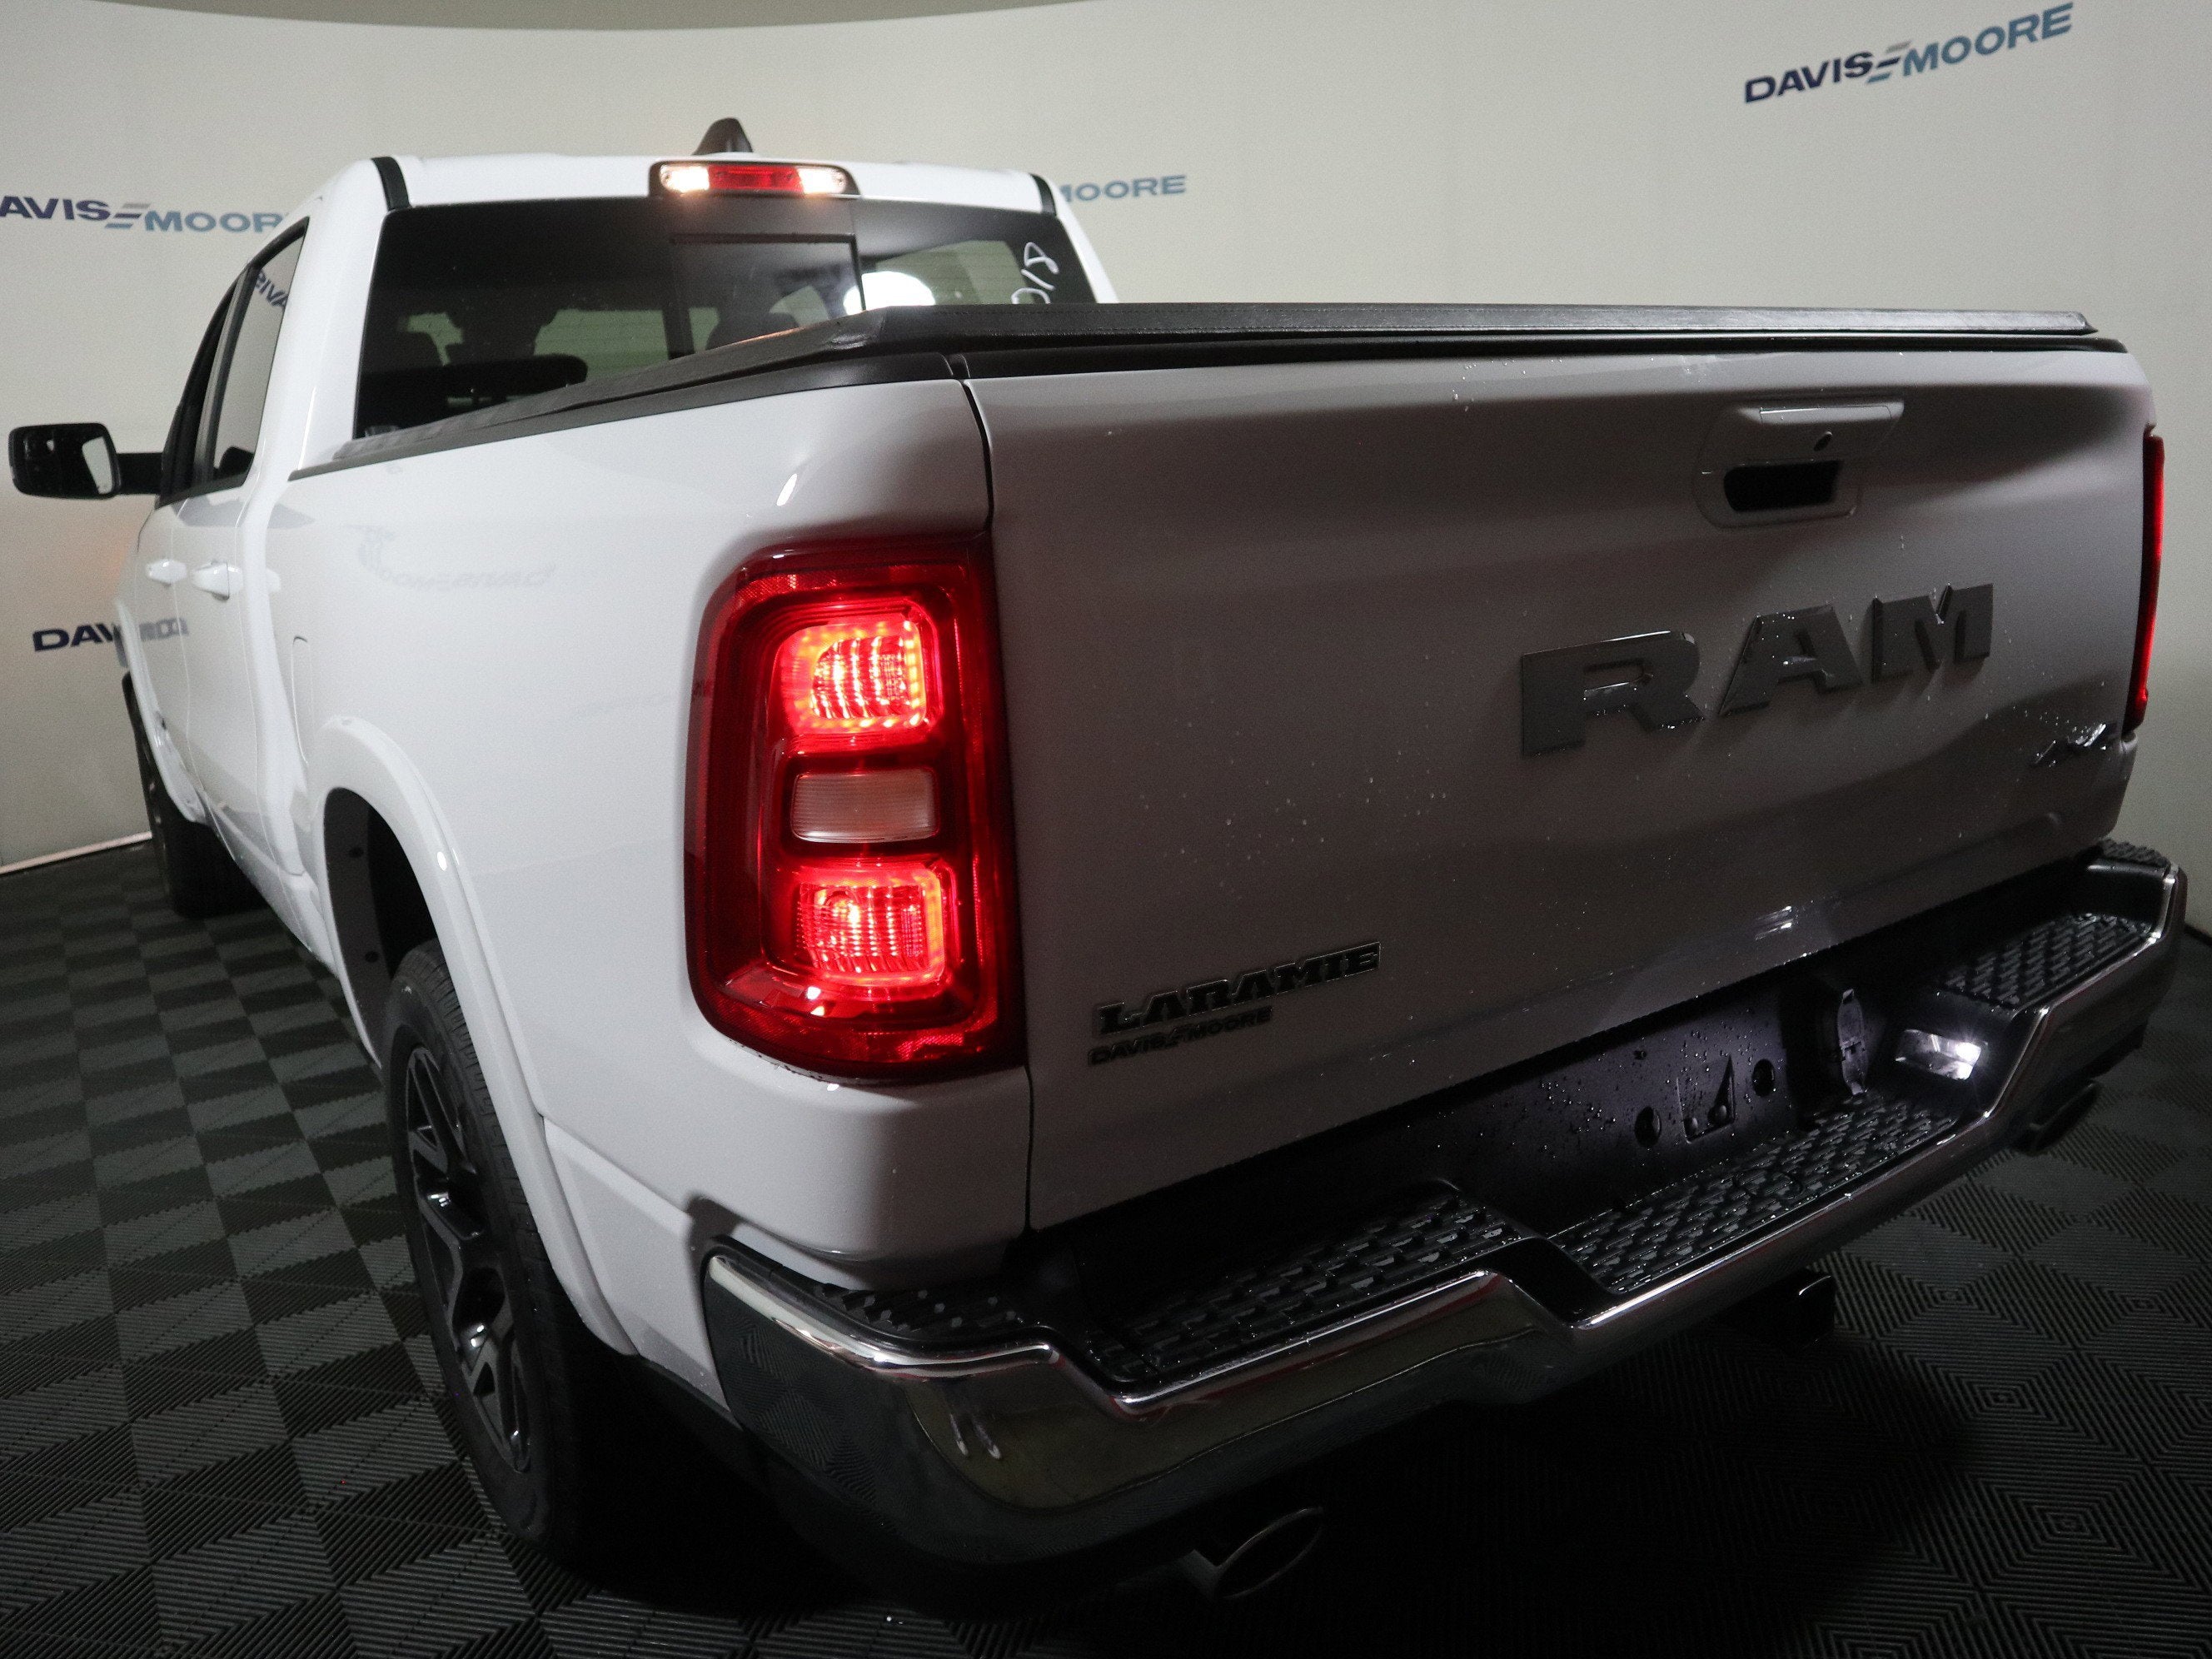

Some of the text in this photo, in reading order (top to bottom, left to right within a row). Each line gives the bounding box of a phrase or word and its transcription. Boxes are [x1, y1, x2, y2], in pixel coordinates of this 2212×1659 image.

[0, 195, 286, 233] AVIS MOOR
[1521, 583, 1994, 760] RAM
[1095, 942, 1381, 1036] LARAMIE
